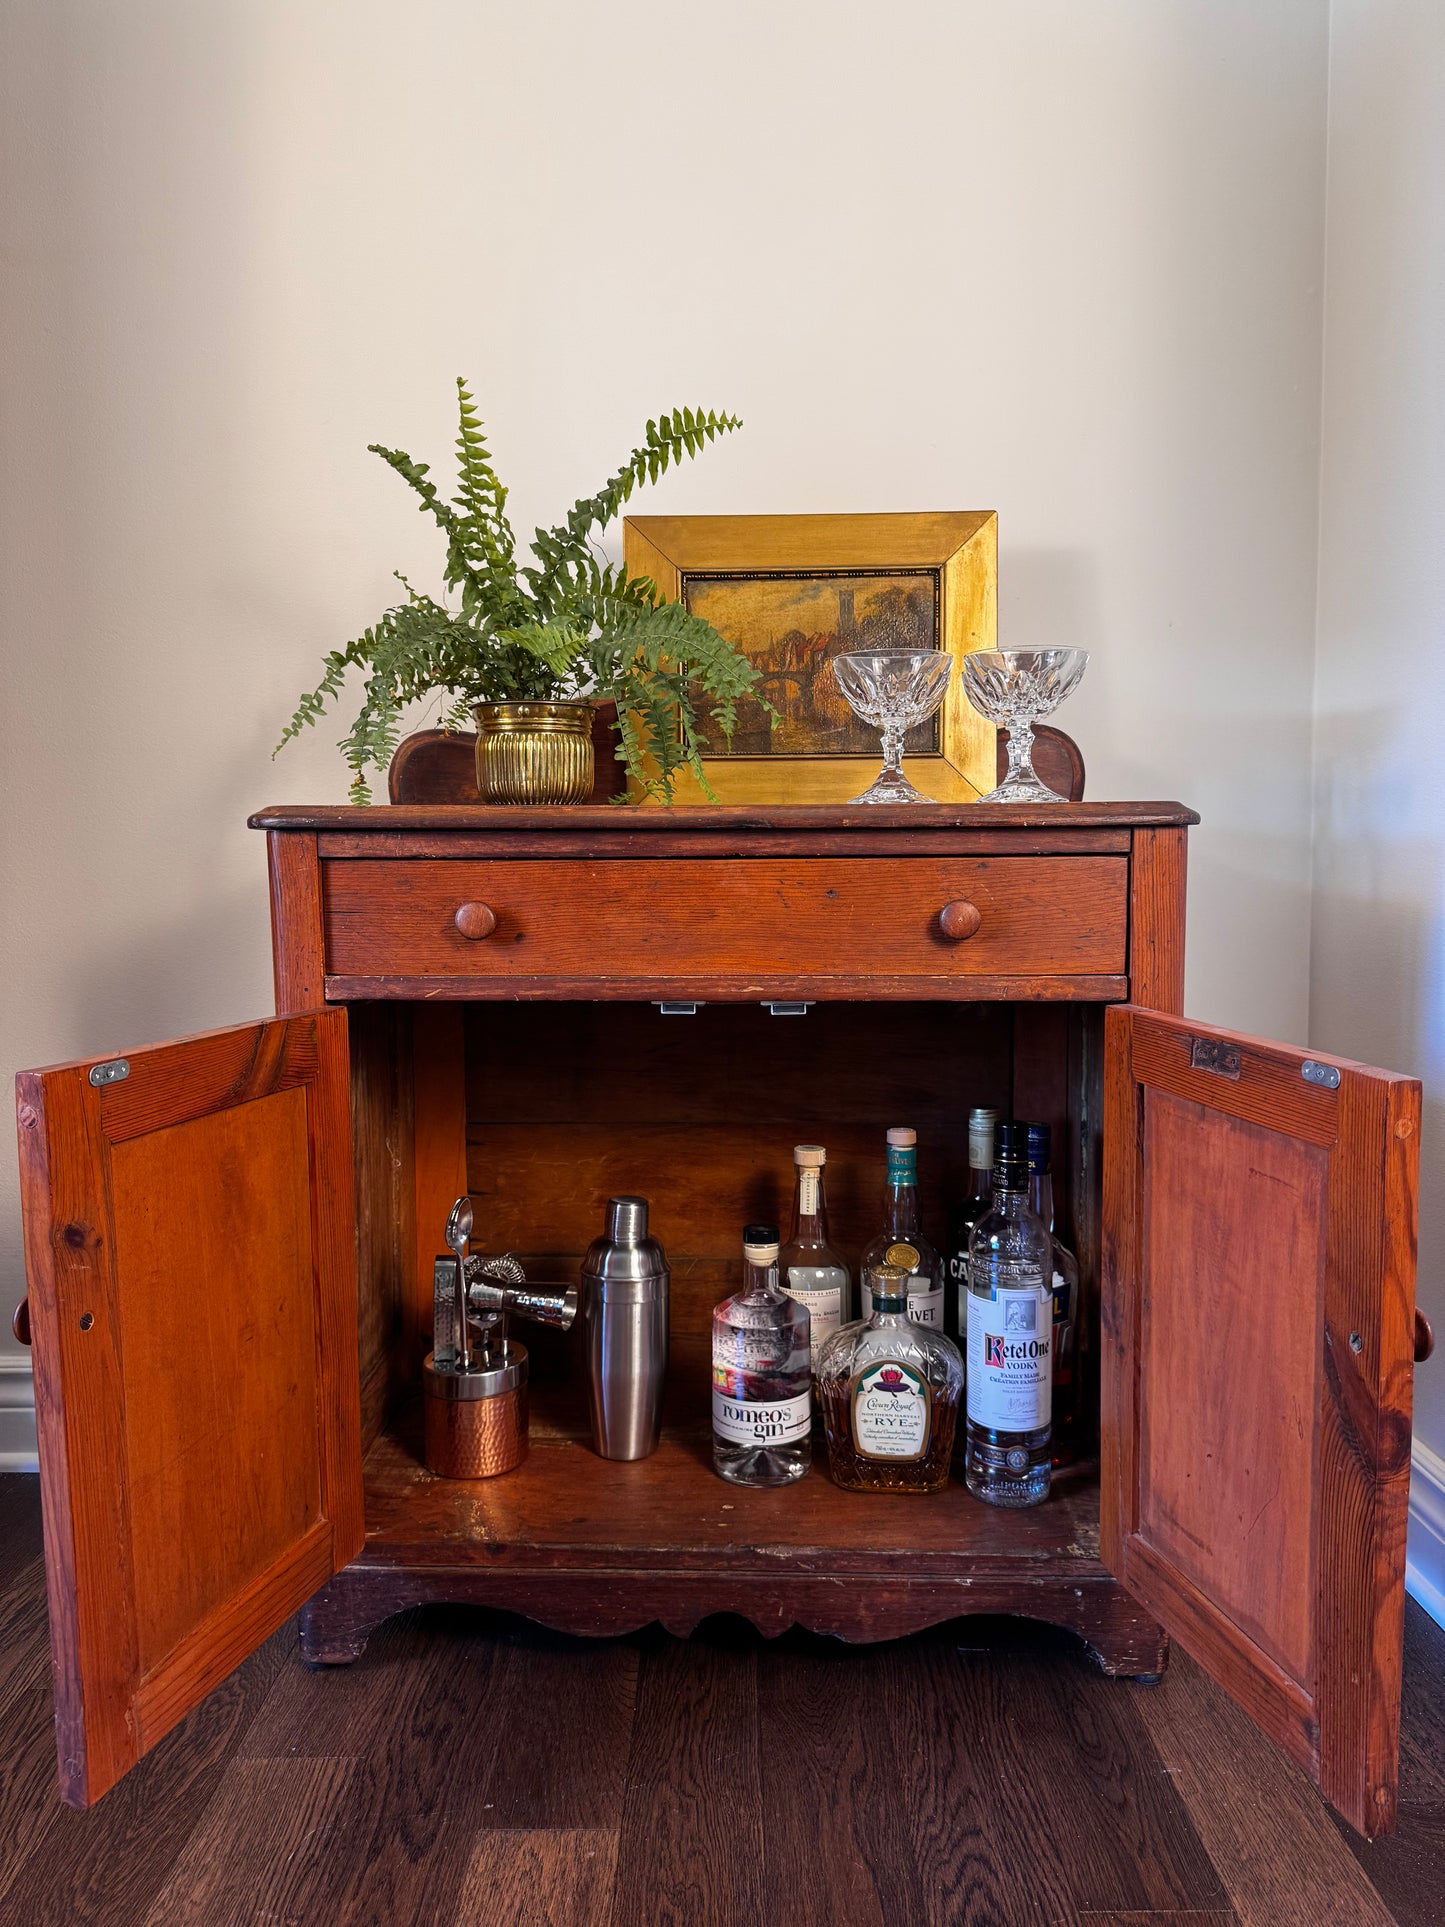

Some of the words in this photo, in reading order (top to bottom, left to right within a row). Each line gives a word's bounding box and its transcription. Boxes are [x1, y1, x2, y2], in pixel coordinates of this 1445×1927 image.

[950, 1258, 968, 1280] CA
[910, 1308, 936, 1321] IVET
[985, 1336, 1027, 1368] Ketel
[1029, 1340, 1049, 1359] One
[1006, 1361, 1038, 1370] VODKA
[867, 1398, 889, 1411] Crown
[886, 1399, 916, 1412] Royal
[722, 1404, 791, 1423] romeo's
[875, 1417, 910, 1427] RYE
[754, 1423, 784, 1443] gin
